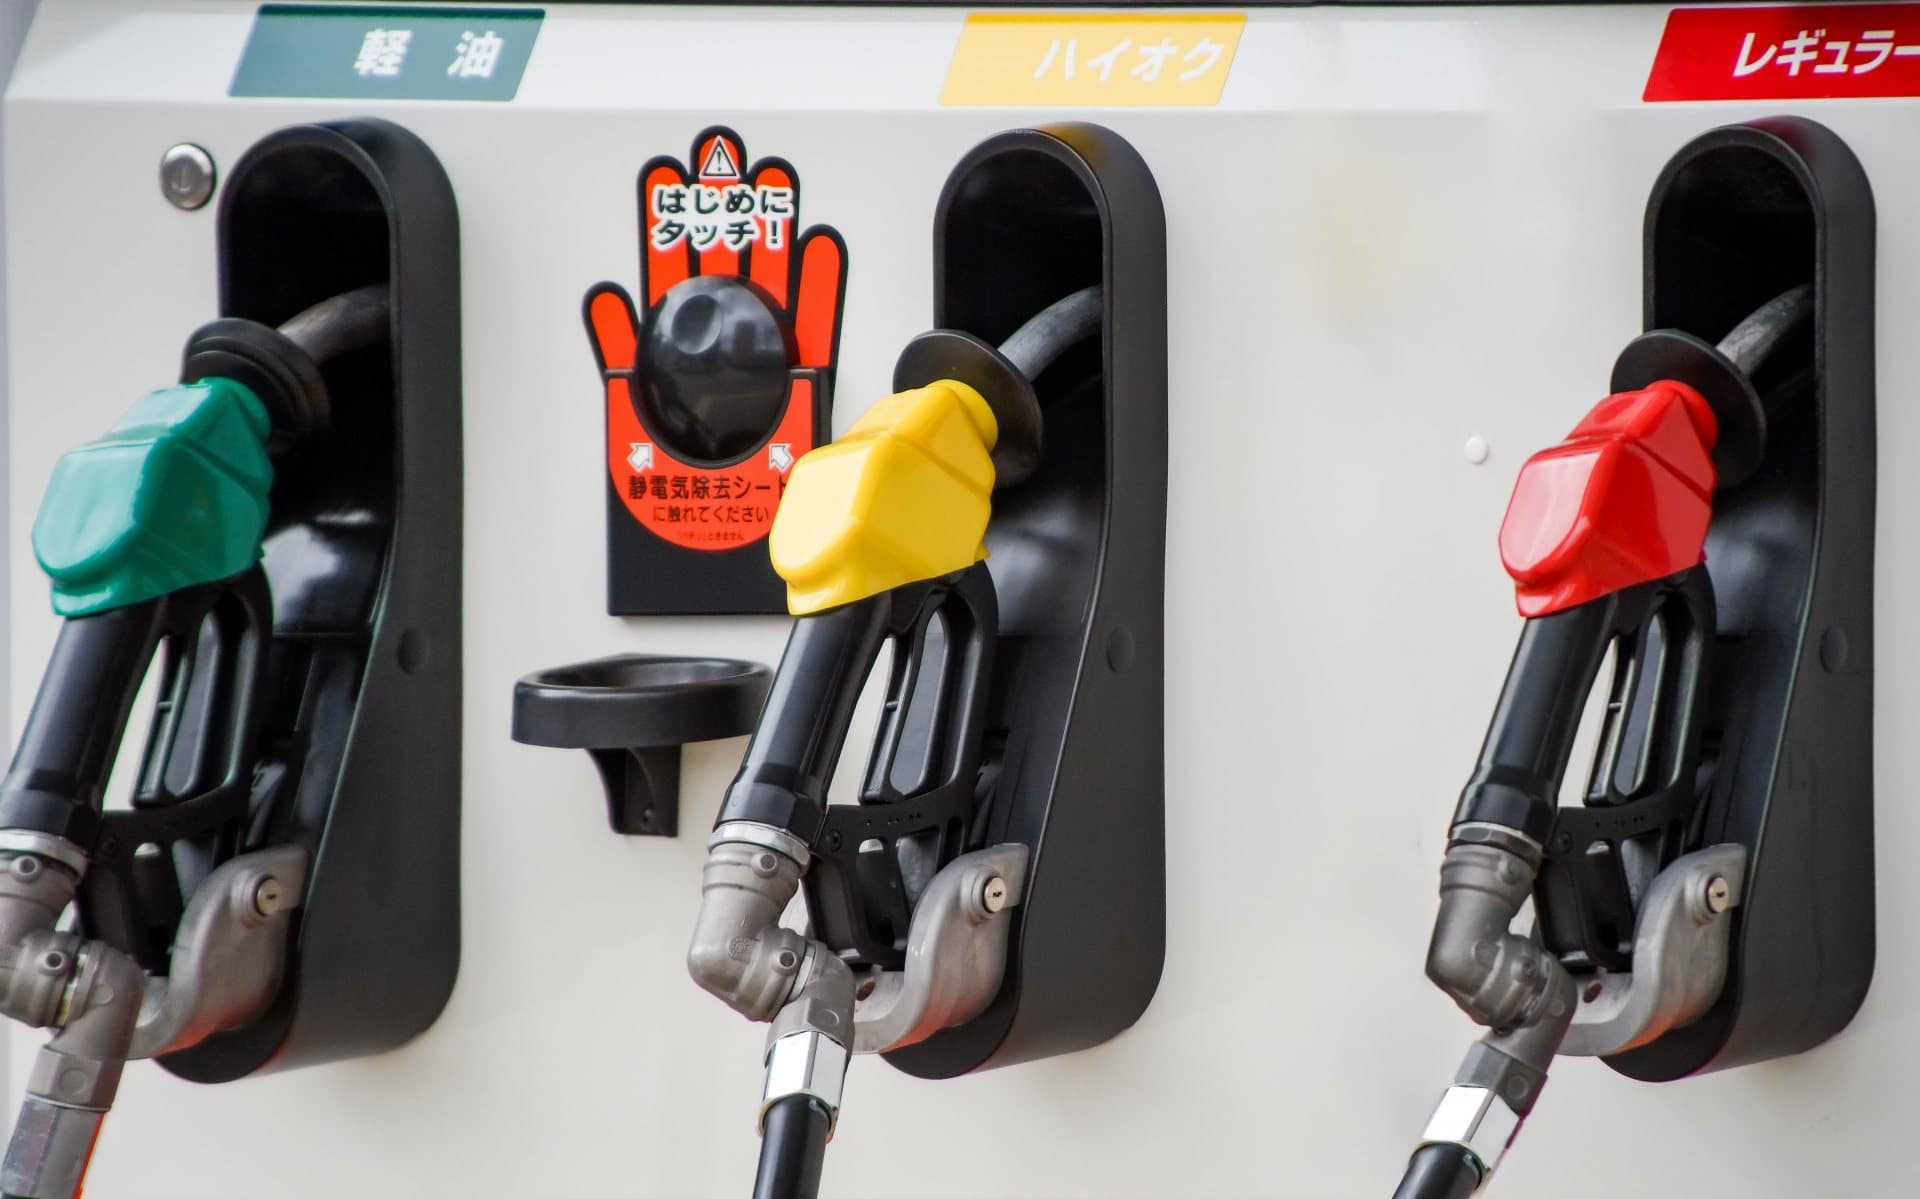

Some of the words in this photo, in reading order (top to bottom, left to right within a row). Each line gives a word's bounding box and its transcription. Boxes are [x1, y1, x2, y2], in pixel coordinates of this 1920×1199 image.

[1032, 37, 1226, 82] ハイオク
[1732, 28, 1920, 77] レギュラー
[657, 188, 789, 215] はじめに
[656, 219, 779, 246] タッチ！
[653, 504, 769, 524] に触れてください
